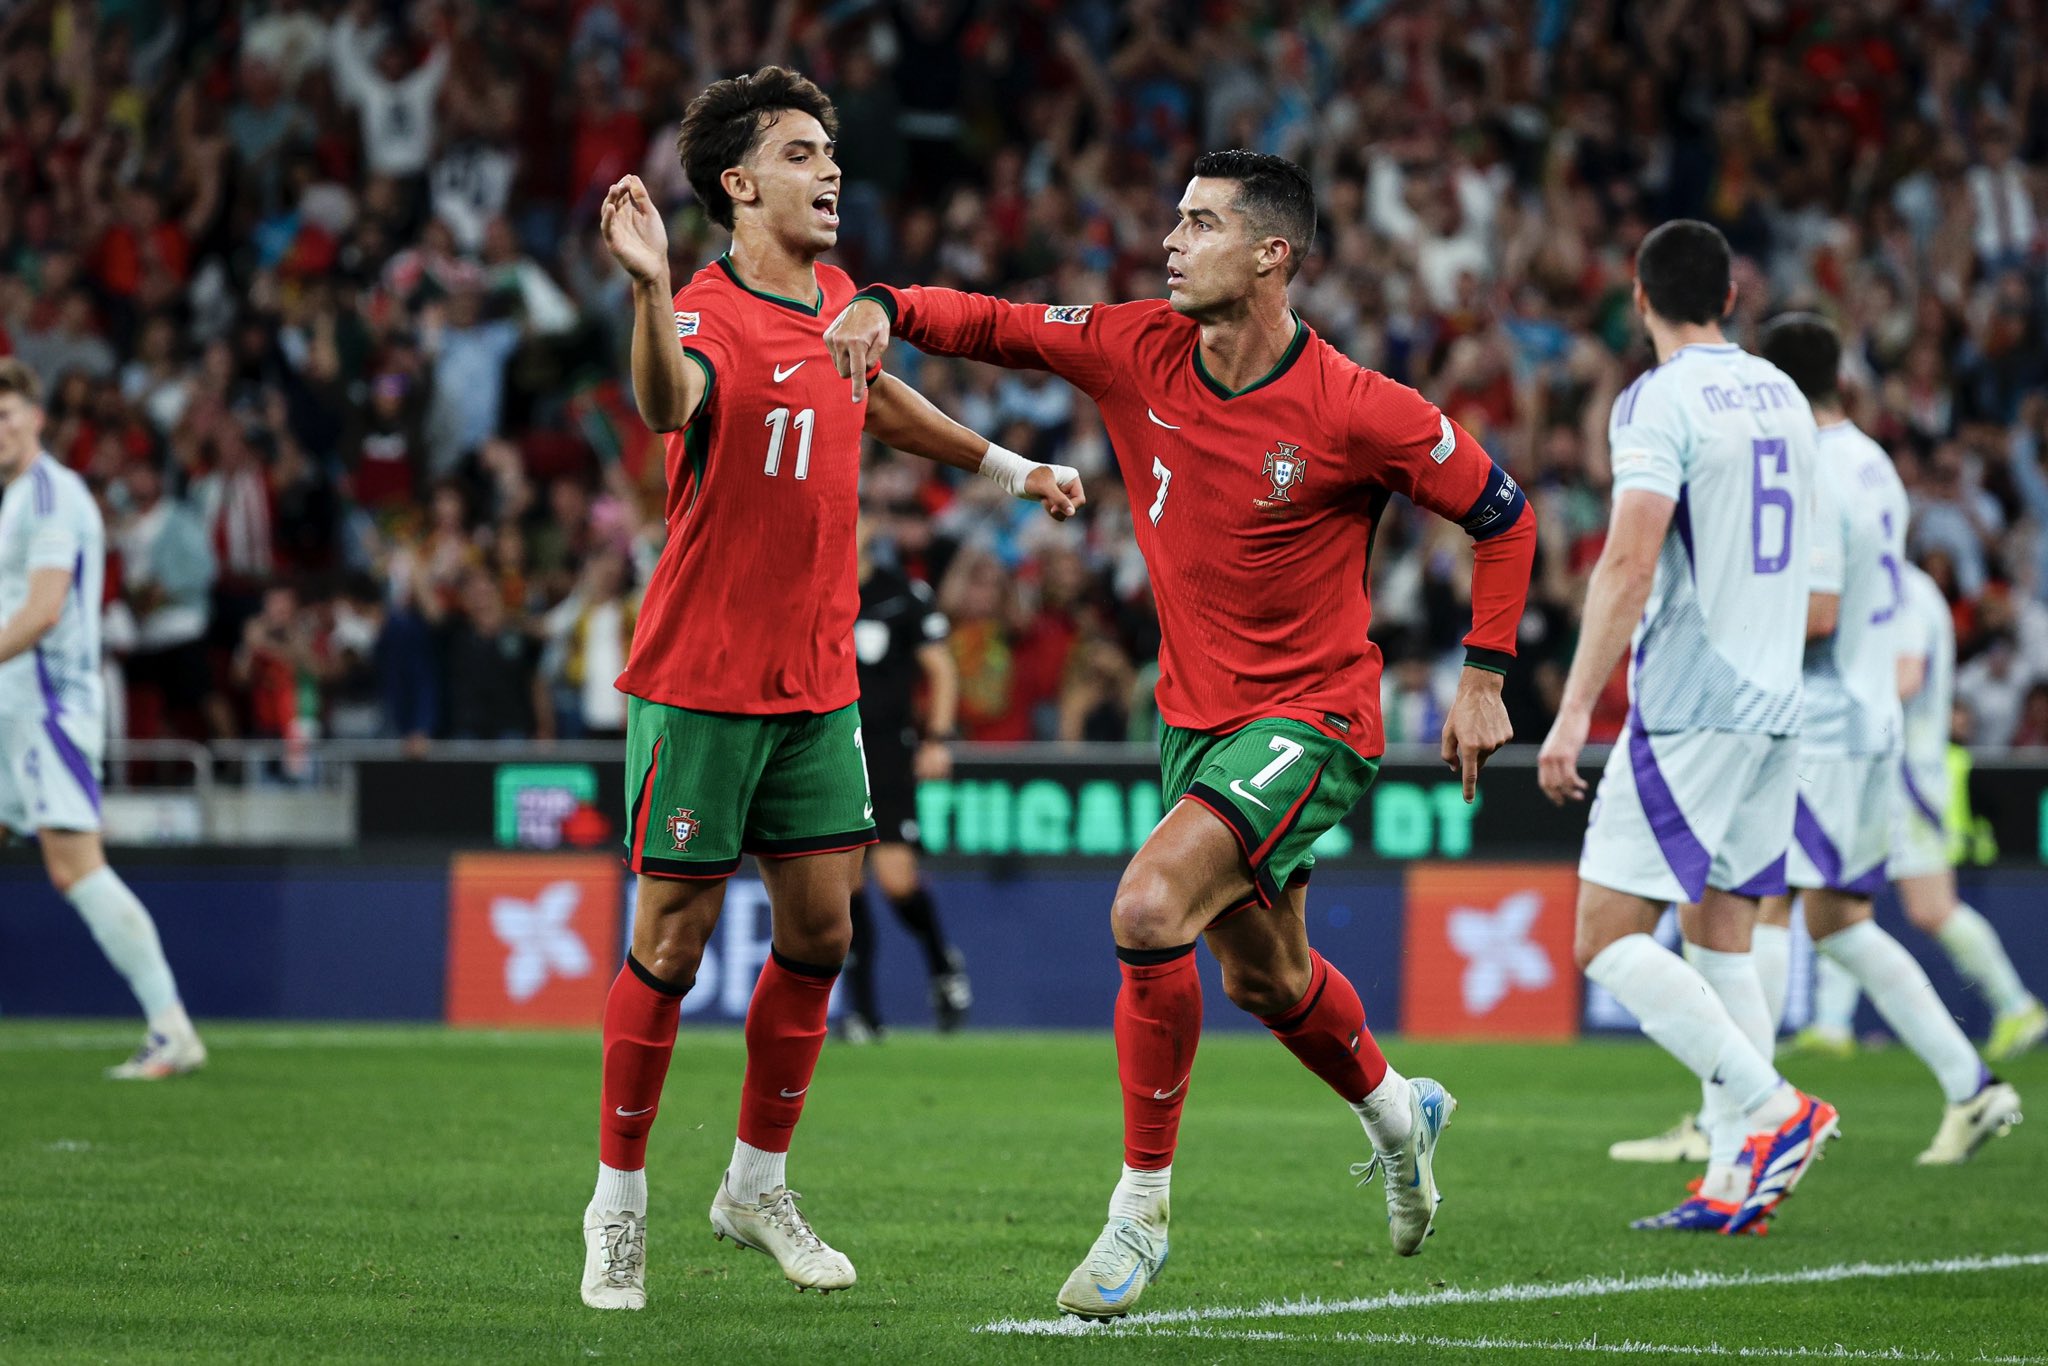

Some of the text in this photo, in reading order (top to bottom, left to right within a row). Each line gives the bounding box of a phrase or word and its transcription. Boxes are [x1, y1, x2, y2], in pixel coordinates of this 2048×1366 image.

[764, 408, 815, 480] 11
[1149, 455, 1172, 529] 7
[1752, 438, 1793, 574] 6
[1249, 735, 1304, 791] 7
